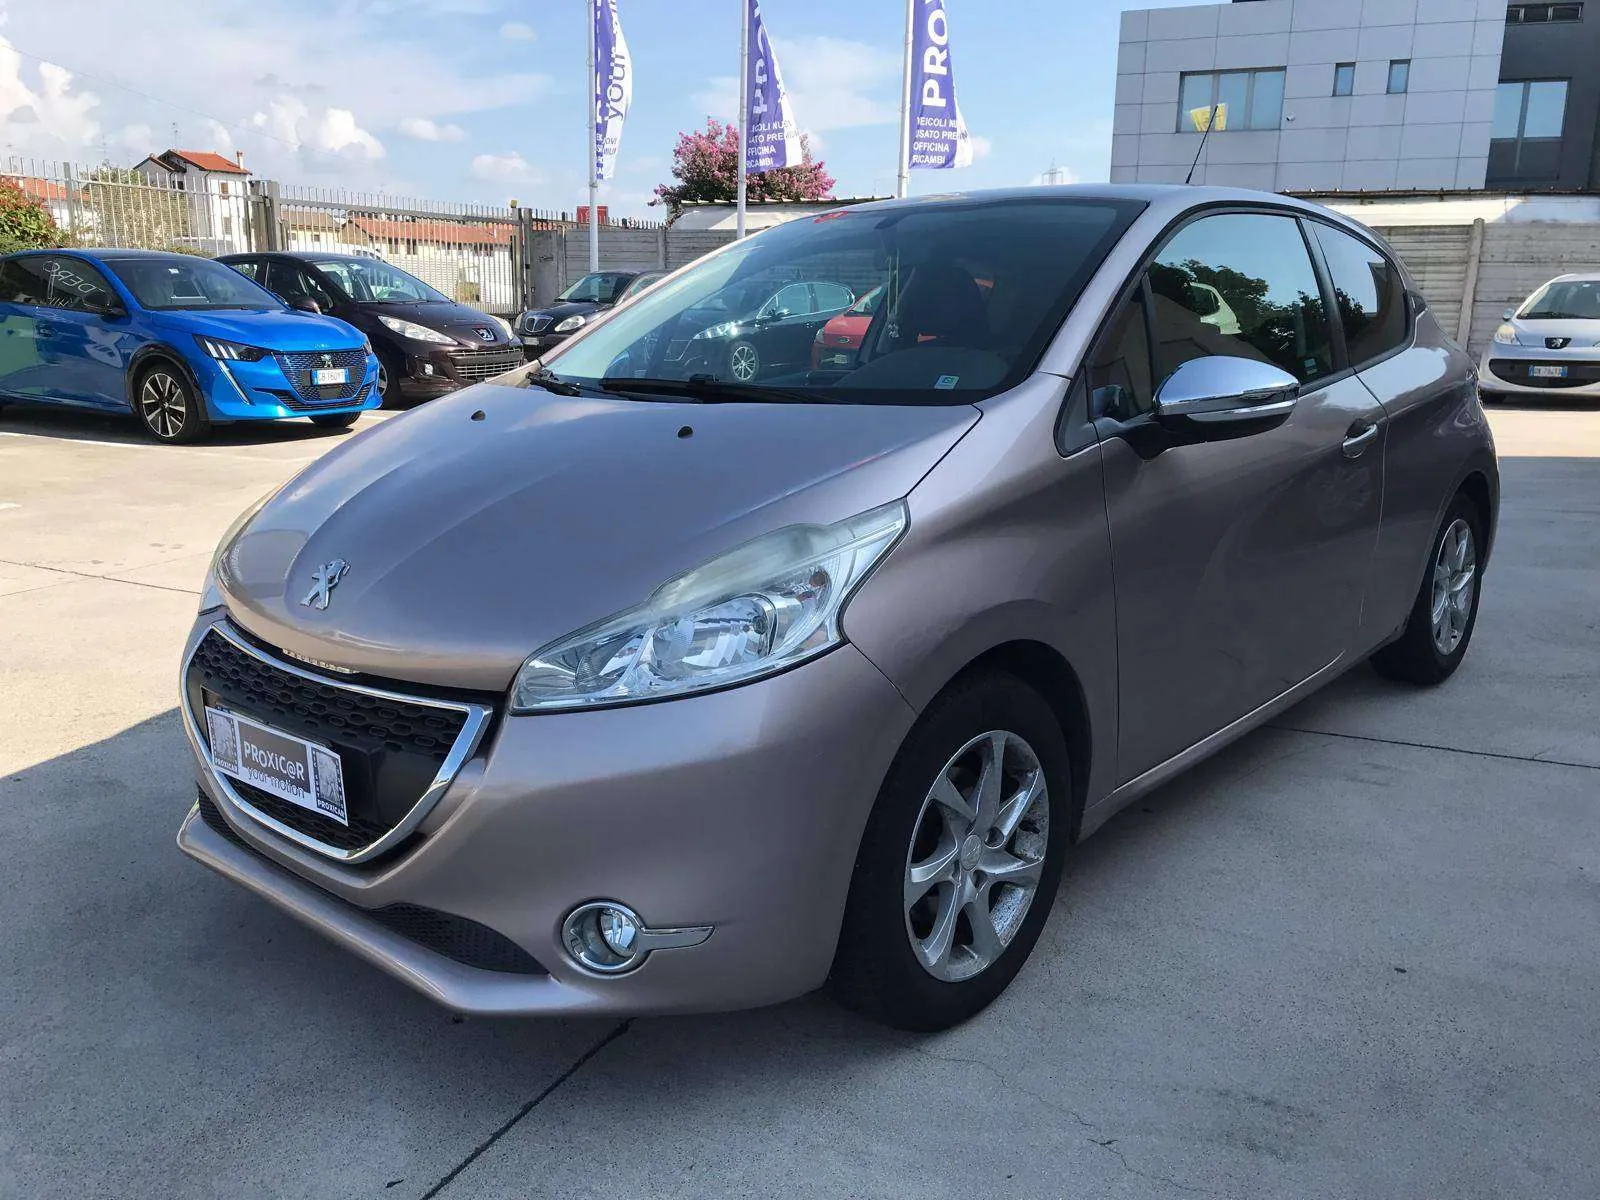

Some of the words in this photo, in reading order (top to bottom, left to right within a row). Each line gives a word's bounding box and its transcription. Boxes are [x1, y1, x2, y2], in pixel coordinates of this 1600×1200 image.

[922, 0, 947, 107] PRO
[747, 145, 777, 157] FFICINA
[913, 142, 949, 153] OFFICINA
[912, 155, 946, 164] RICAMBI
[248, 767, 268, 783] your
[270, 775, 305, 799] motion
